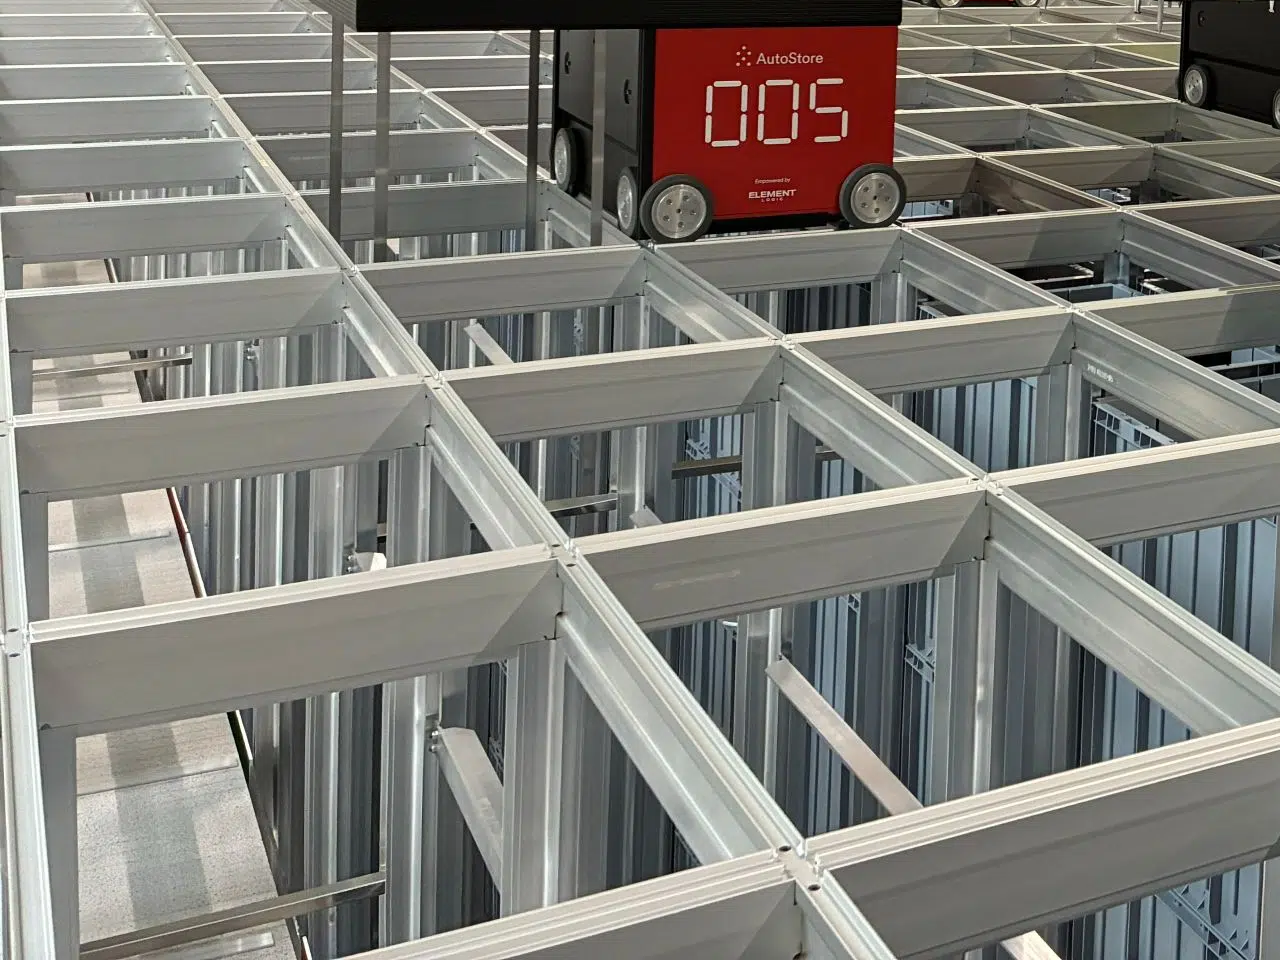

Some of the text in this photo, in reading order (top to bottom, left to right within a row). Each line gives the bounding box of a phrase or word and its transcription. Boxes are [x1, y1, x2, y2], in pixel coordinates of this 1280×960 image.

[756, 52, 824, 65] AutoStore
[705, 78, 849, 147] 005
[748, 189, 797, 199] ELEMENT
